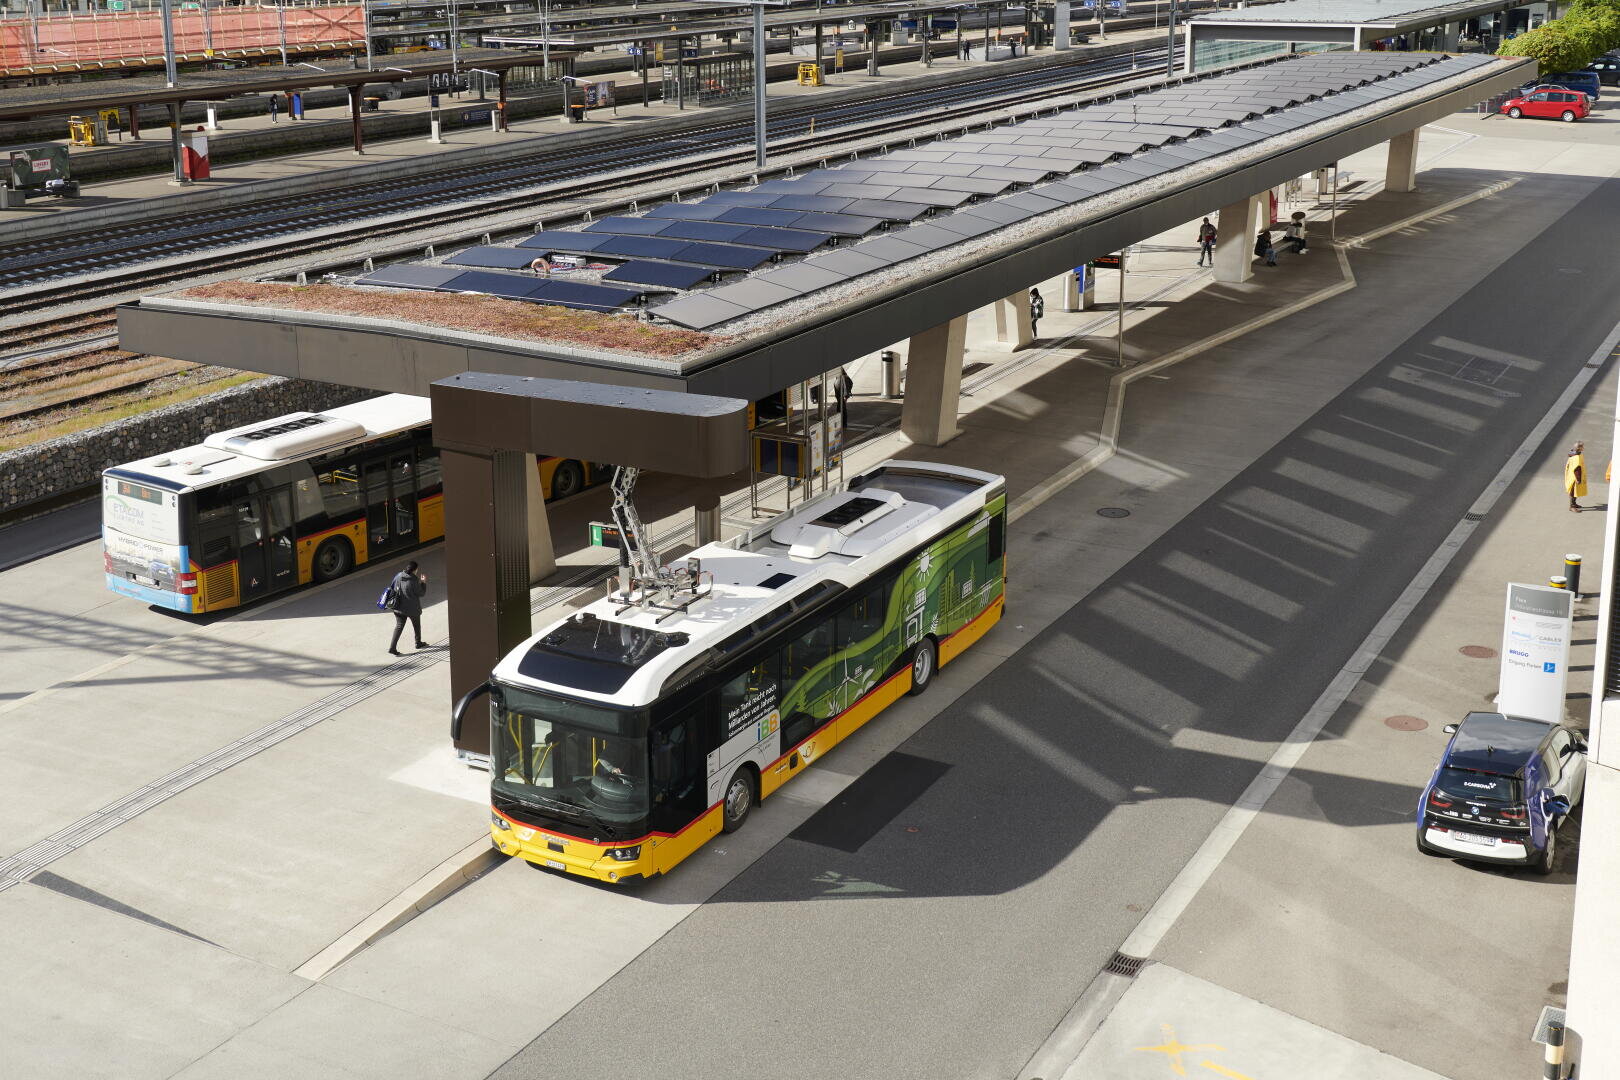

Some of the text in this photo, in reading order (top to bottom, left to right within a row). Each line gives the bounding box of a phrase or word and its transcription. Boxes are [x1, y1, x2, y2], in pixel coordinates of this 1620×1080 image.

[592, 528, 600, 541] L
[1509, 649, 1529, 658] BRUGG
[729, 708, 740, 720] Mein
[765, 683, 777, 695] noch
[751, 704, 760, 714] von
